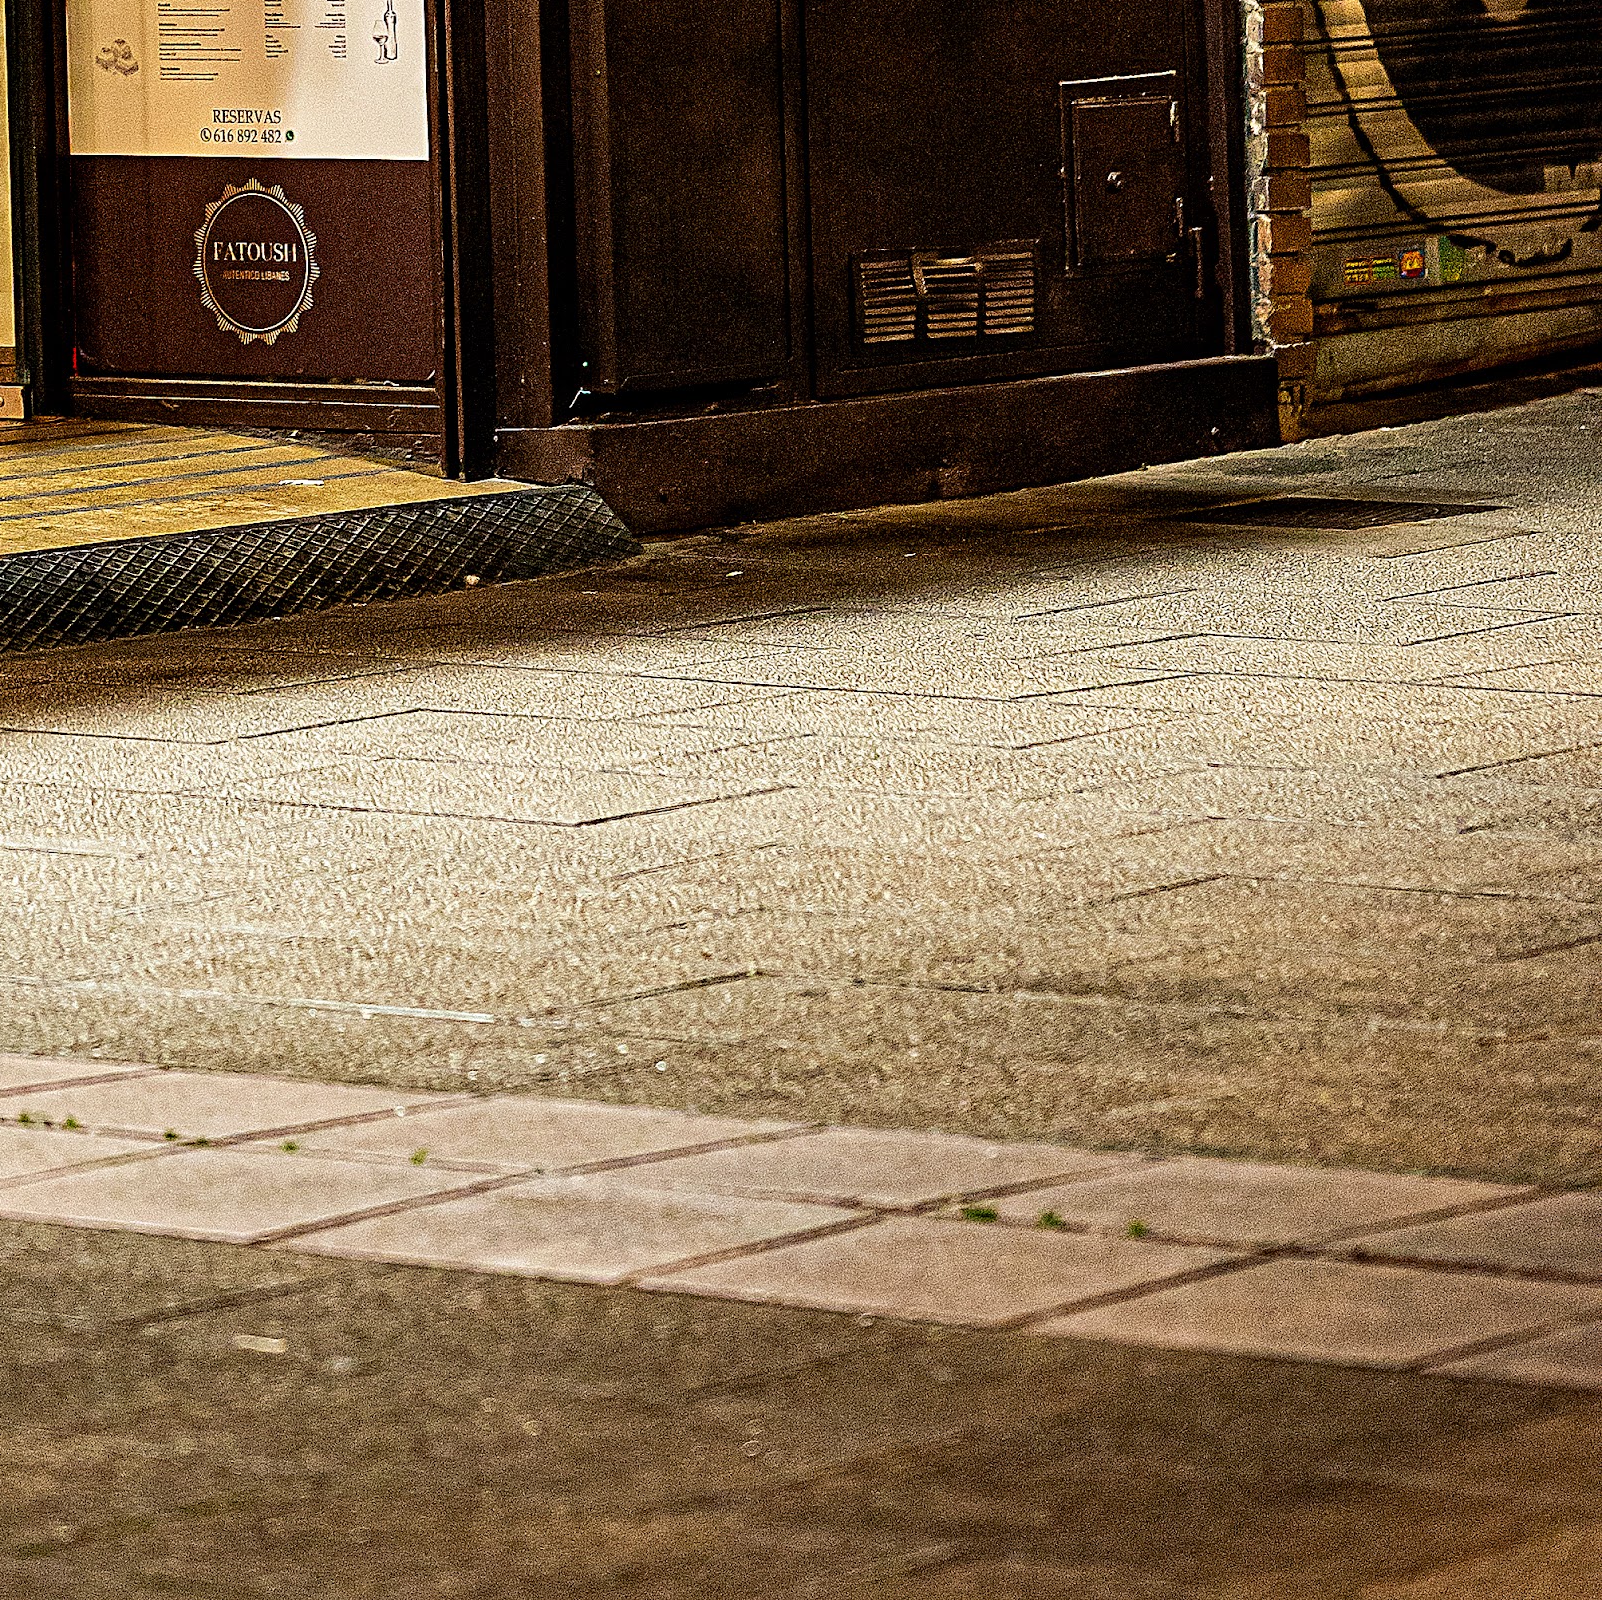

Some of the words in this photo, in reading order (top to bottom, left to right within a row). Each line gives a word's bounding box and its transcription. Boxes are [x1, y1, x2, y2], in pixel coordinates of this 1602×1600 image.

[212, 109, 282, 124] RESERVAS
[213, 129, 235, 143] 616
[237, 129, 258, 143] 892
[260, 129, 282, 143] 482
[213, 241, 297, 262] FATOUSH
